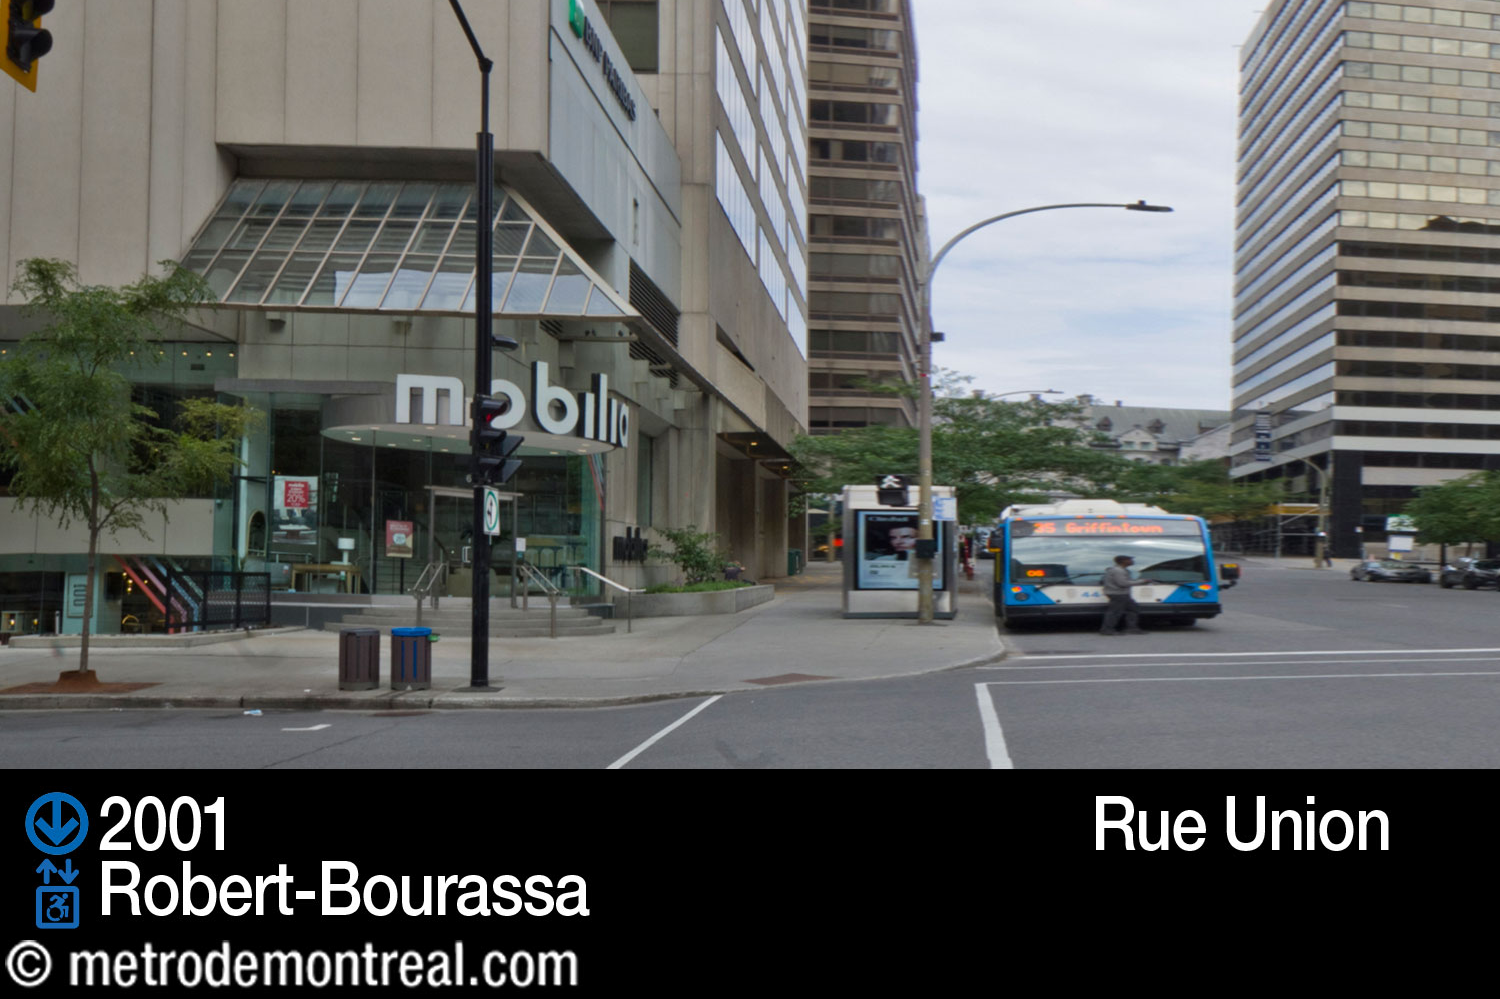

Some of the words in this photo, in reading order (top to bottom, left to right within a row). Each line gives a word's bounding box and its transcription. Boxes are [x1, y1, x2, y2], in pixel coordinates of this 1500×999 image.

[396, 360, 630, 448] mobilia
[1034, 522, 1056, 534] 35
[1065, 522, 1163, 534] Griffintown
